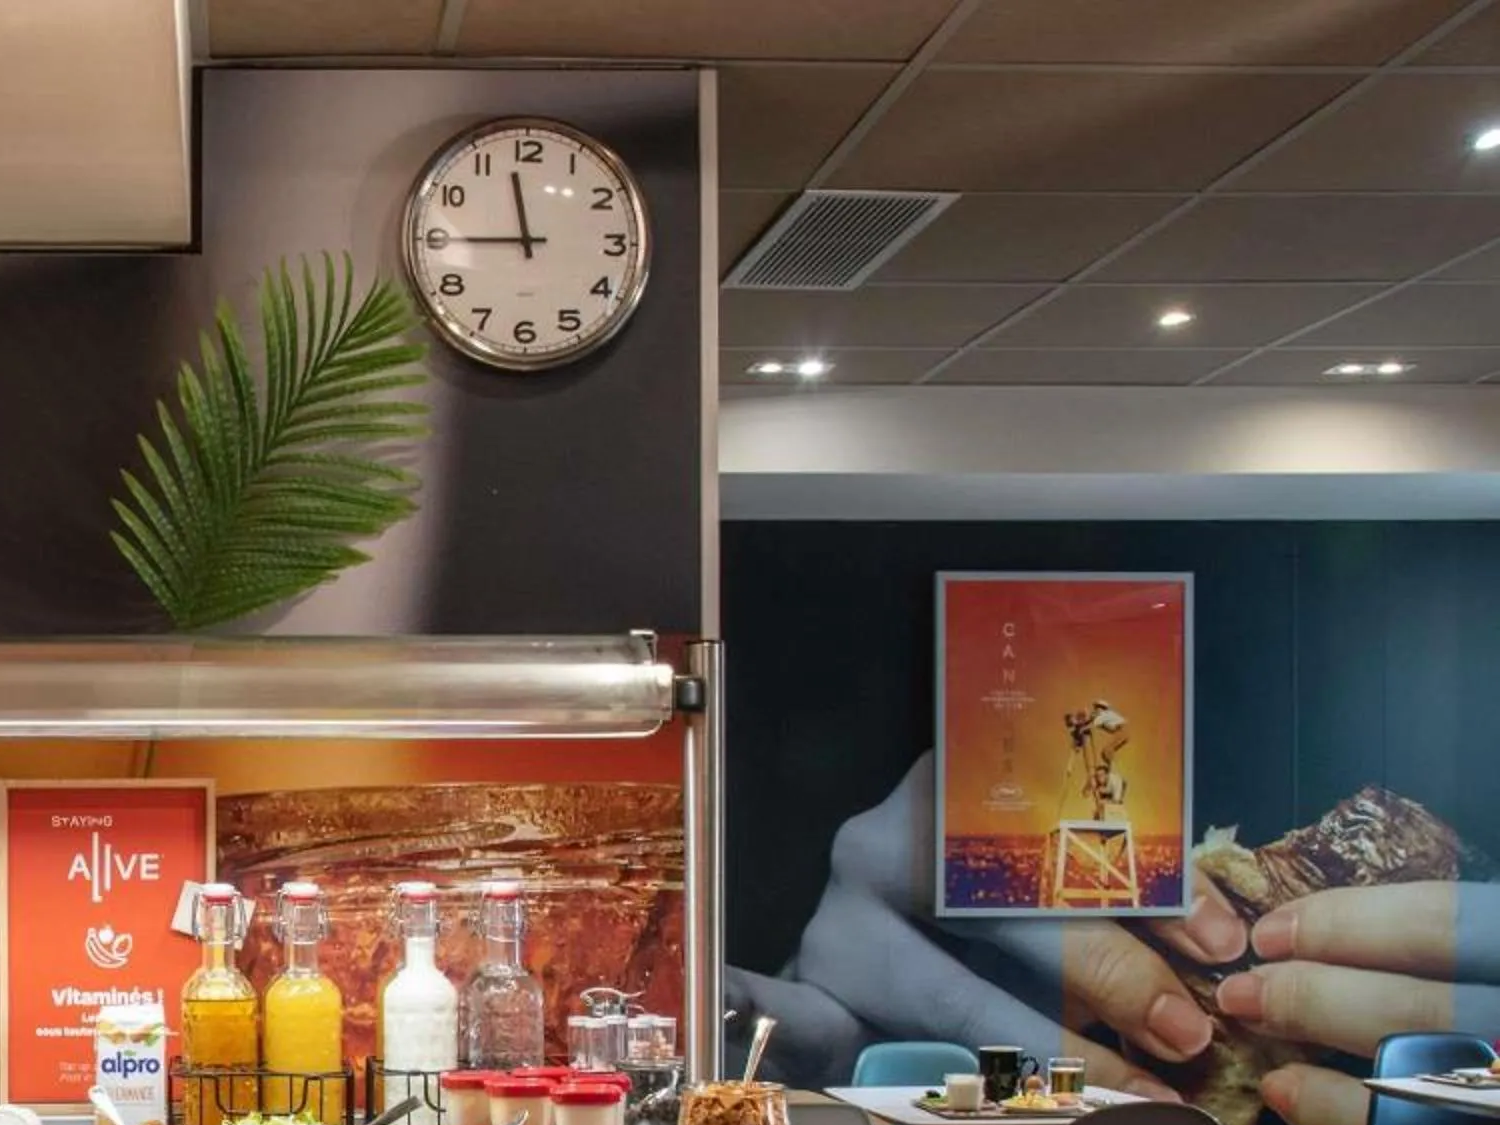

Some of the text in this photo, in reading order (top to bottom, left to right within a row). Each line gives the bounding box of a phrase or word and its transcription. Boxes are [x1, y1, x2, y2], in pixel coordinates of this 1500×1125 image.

[515, 140, 543, 163] 12
[474, 153, 490, 176] 11
[569, 154, 576, 175] 1
[442, 186, 465, 207] 10
[591, 188, 613, 210] 2
[426, 228, 449, 250] 9
[603, 234, 626, 257] 3
[439, 274, 465, 296] 8
[589, 276, 612, 298] 4
[472, 308, 492, 331] 7
[557, 310, 581, 332] 5
[513, 321, 537, 344] 6
[101, 1051, 160, 1078] alpro
